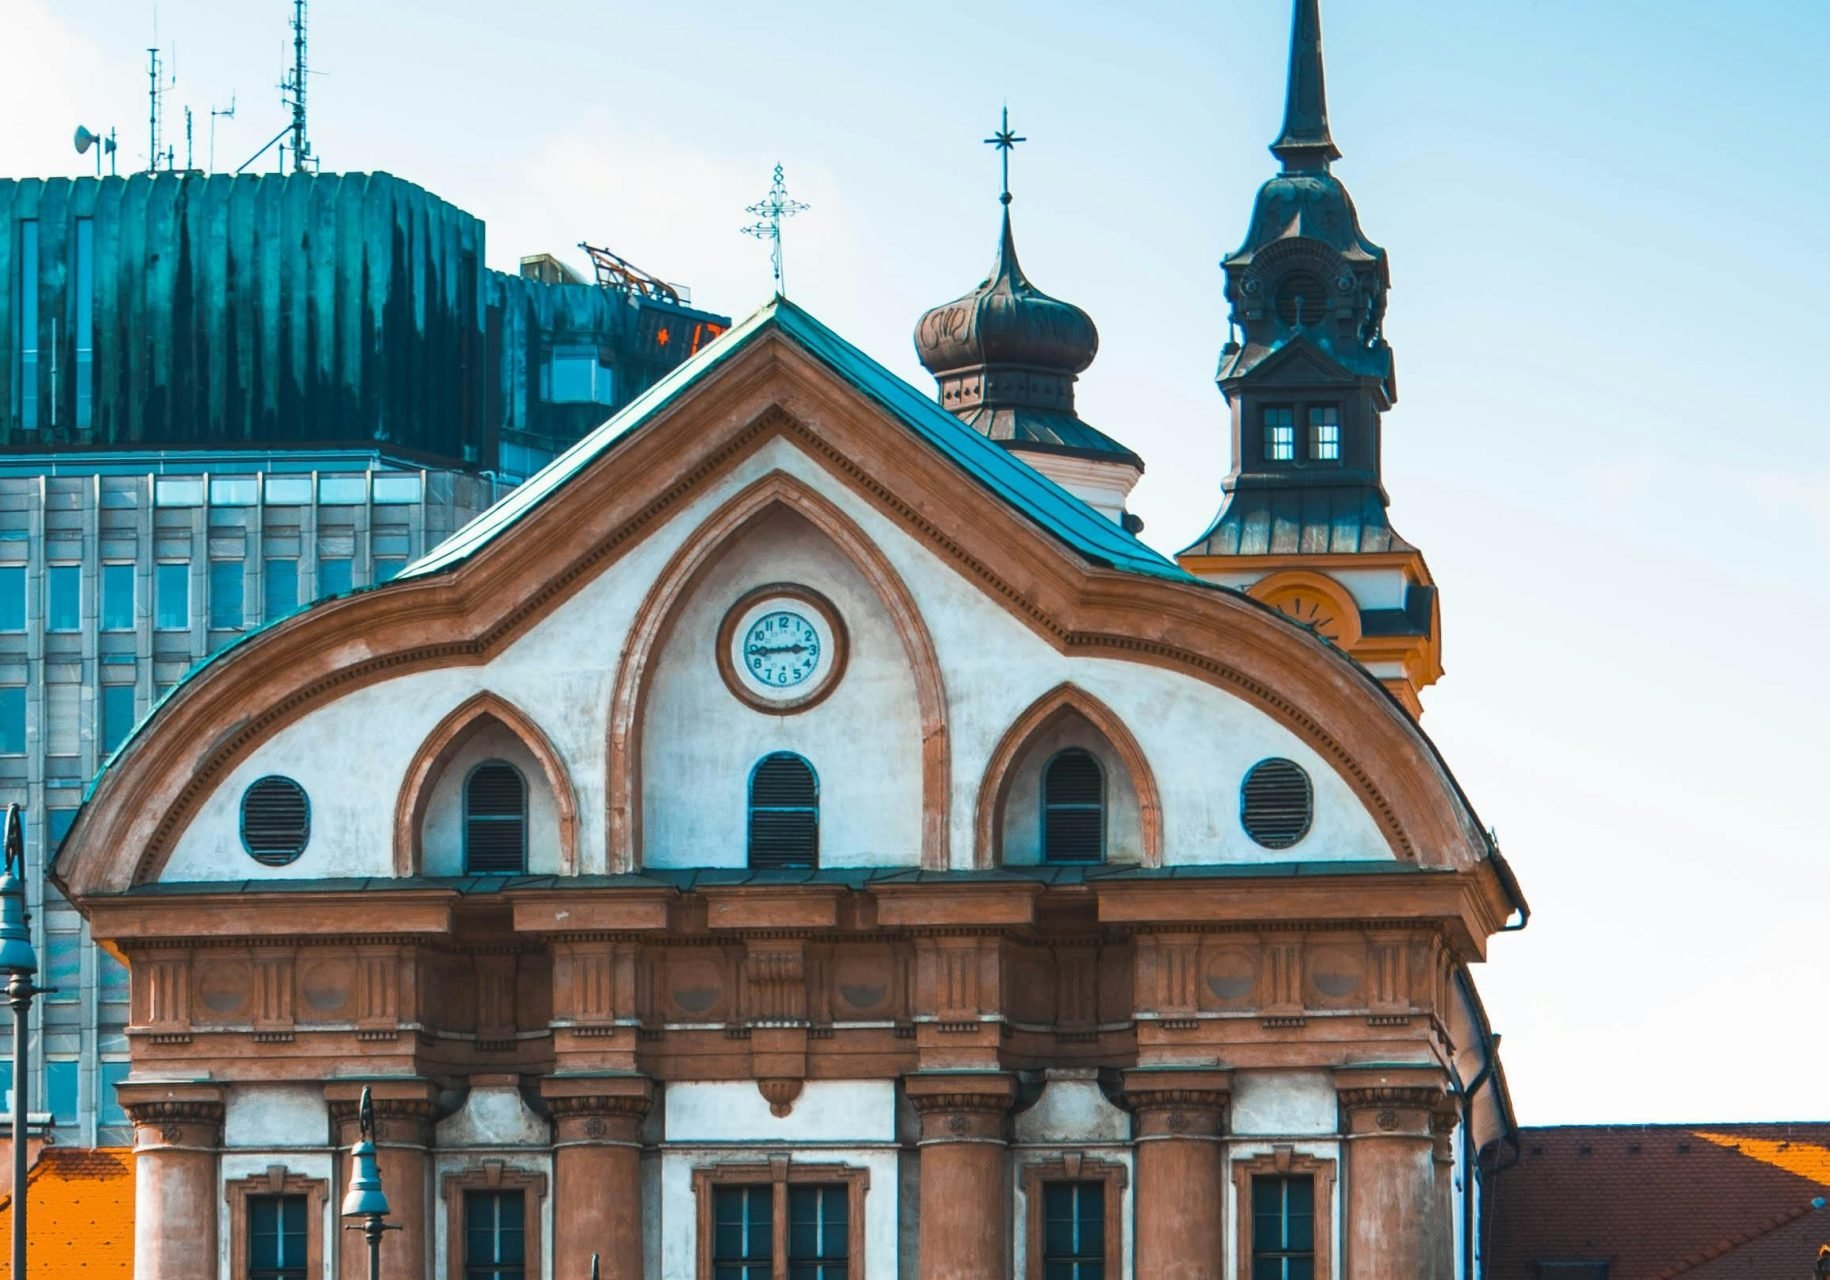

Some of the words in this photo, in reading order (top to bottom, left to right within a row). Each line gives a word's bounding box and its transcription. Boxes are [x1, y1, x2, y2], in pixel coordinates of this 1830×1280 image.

[766, 621, 773, 632] 11
[779, 617, 789, 628] 12
[796, 621, 800, 632] 1
[755, 630, 765, 641] 10
[804, 630, 812, 641] 2
[809, 645, 816, 656] 3
[754, 658, 762, 669] 8
[802, 658, 811, 668] 4
[765, 669, 772, 680] 7
[778, 672, 787, 683] 6
[793, 669, 801, 679] 5
